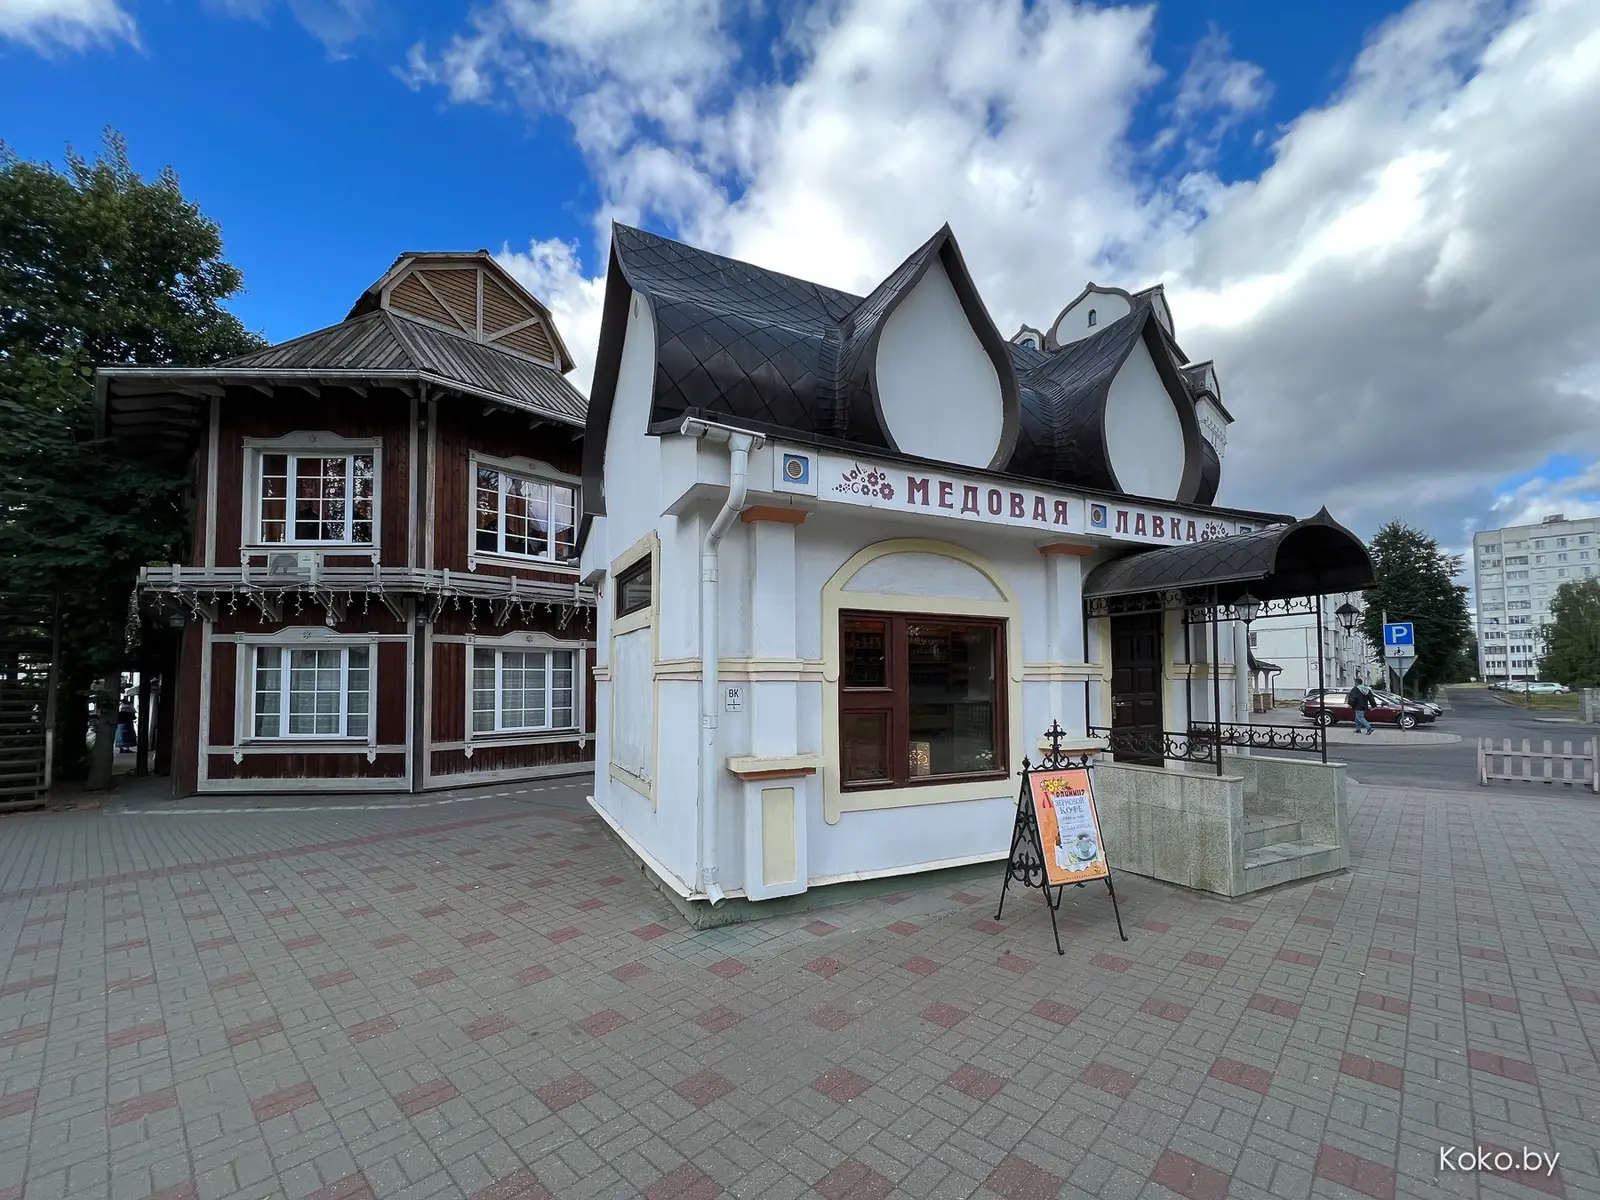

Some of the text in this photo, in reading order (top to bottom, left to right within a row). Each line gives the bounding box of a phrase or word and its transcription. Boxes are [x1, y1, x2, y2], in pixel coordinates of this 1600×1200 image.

[907, 476, 1197, 542] МЕДОВАЯ ЛАВКА
[1391, 626, 1408, 644] P
[1060, 806, 1084, 815] КОФЕ
